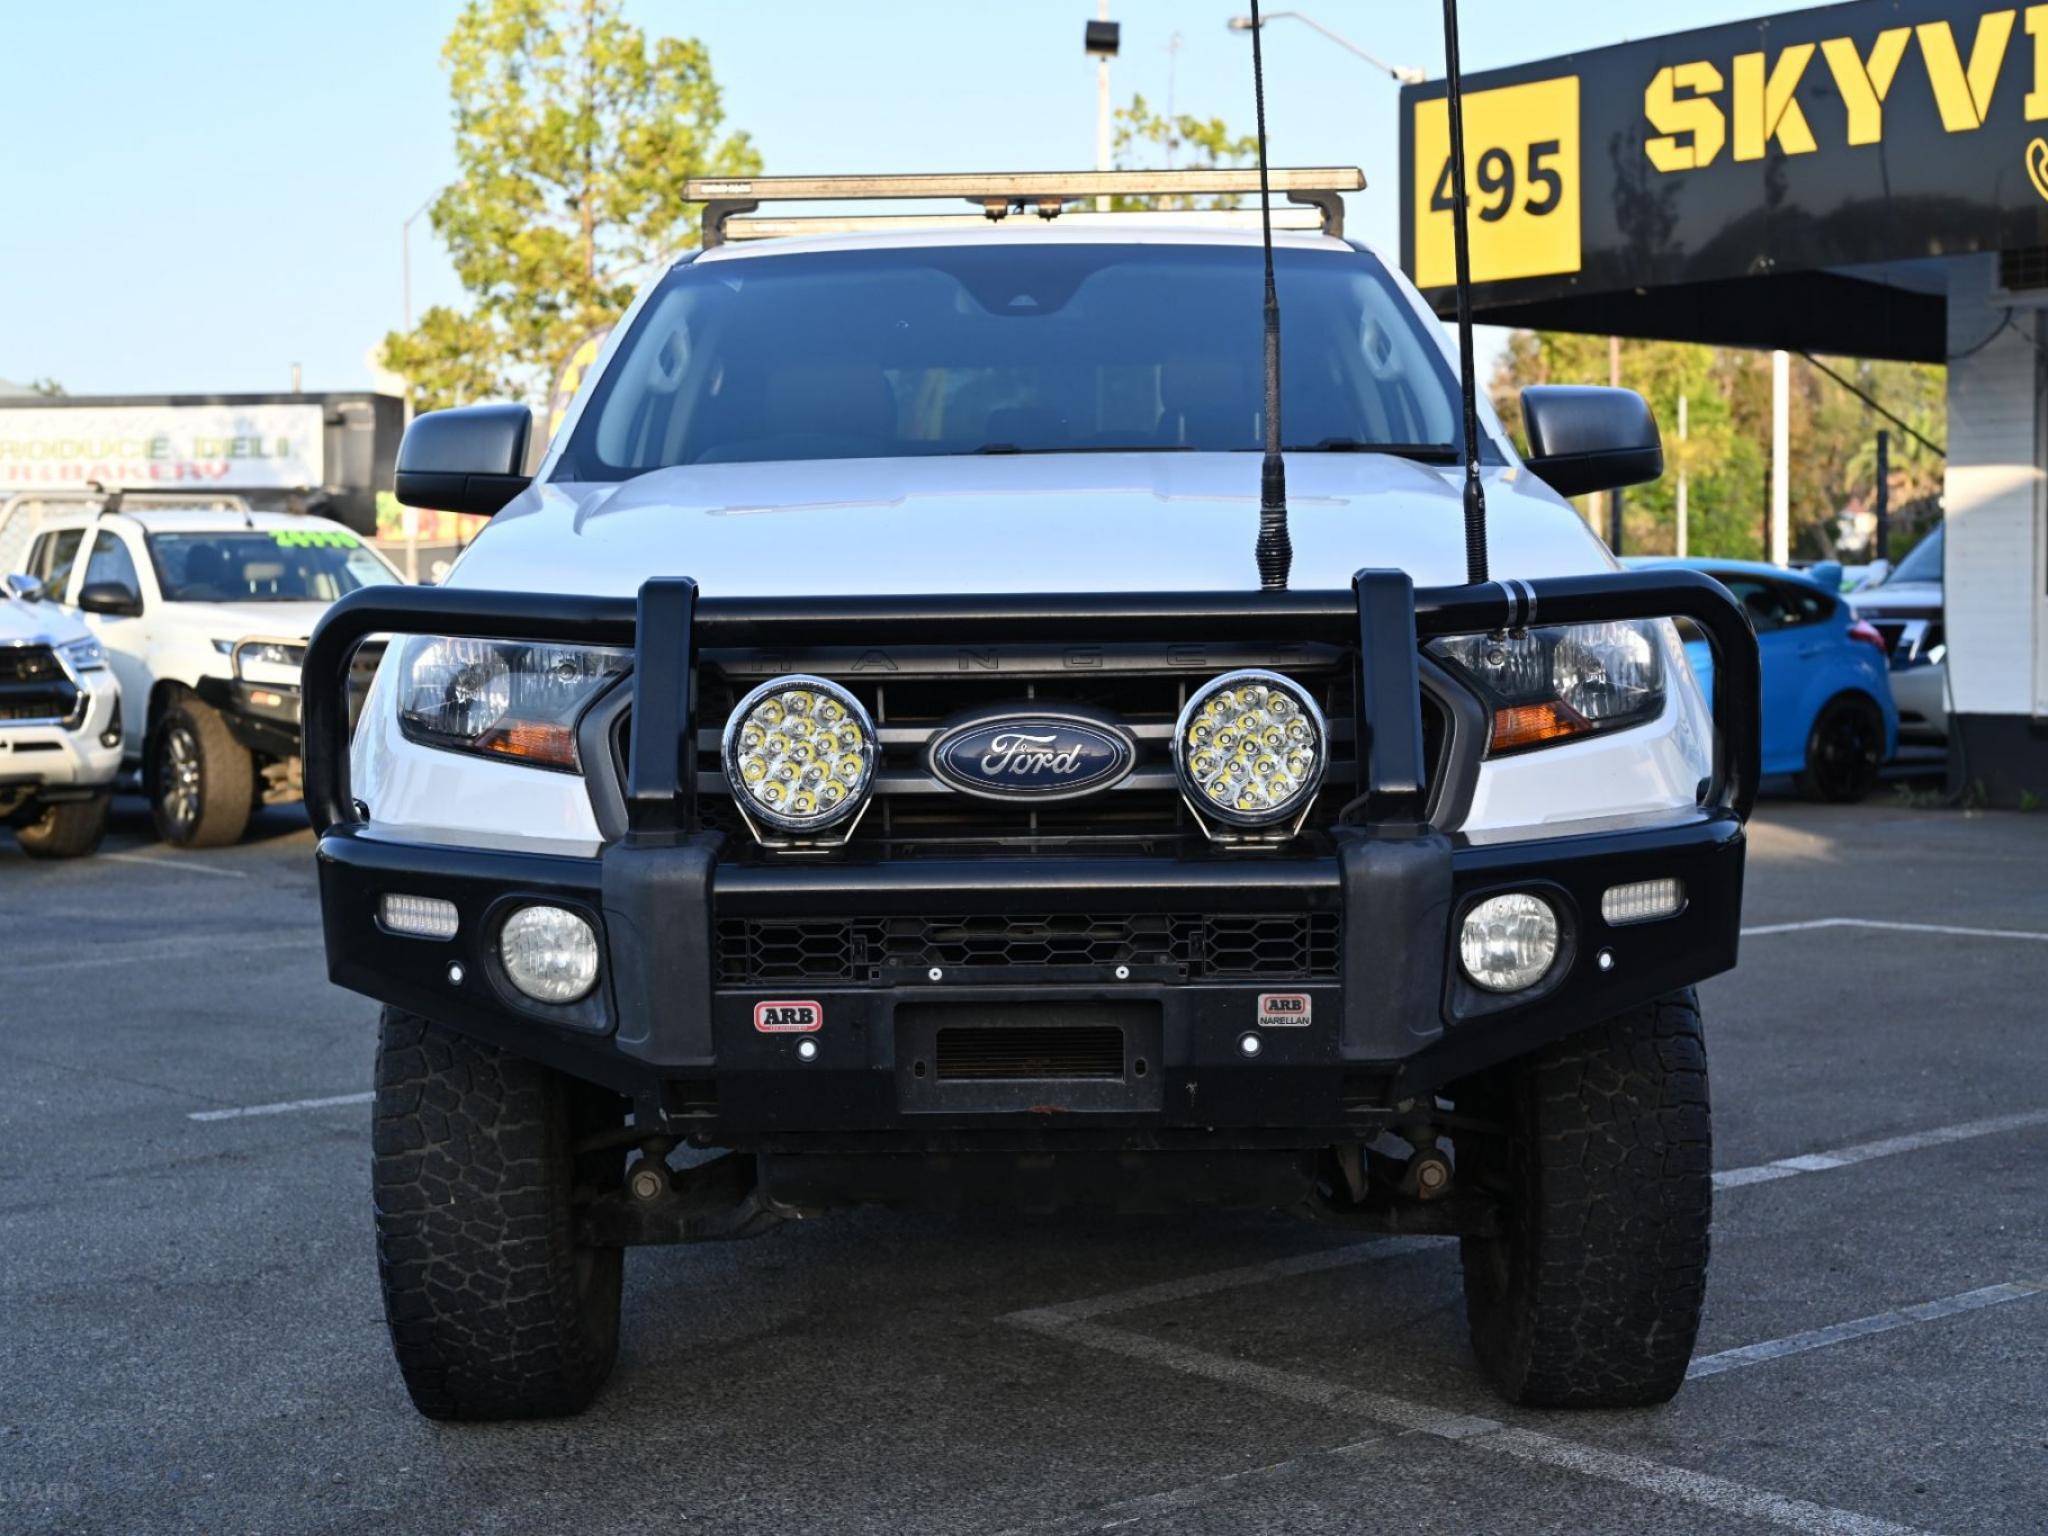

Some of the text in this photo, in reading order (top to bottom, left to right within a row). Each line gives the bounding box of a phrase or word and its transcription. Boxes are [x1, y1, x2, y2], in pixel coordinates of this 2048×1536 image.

[1430, 139, 1562, 222] 495
[981, 733, 1083, 775] Ford
[1268, 1000, 1302, 1011] ARB
[763, 1007, 814, 1025] ARB
[1260, 1016, 1310, 1025] NARELLAN
